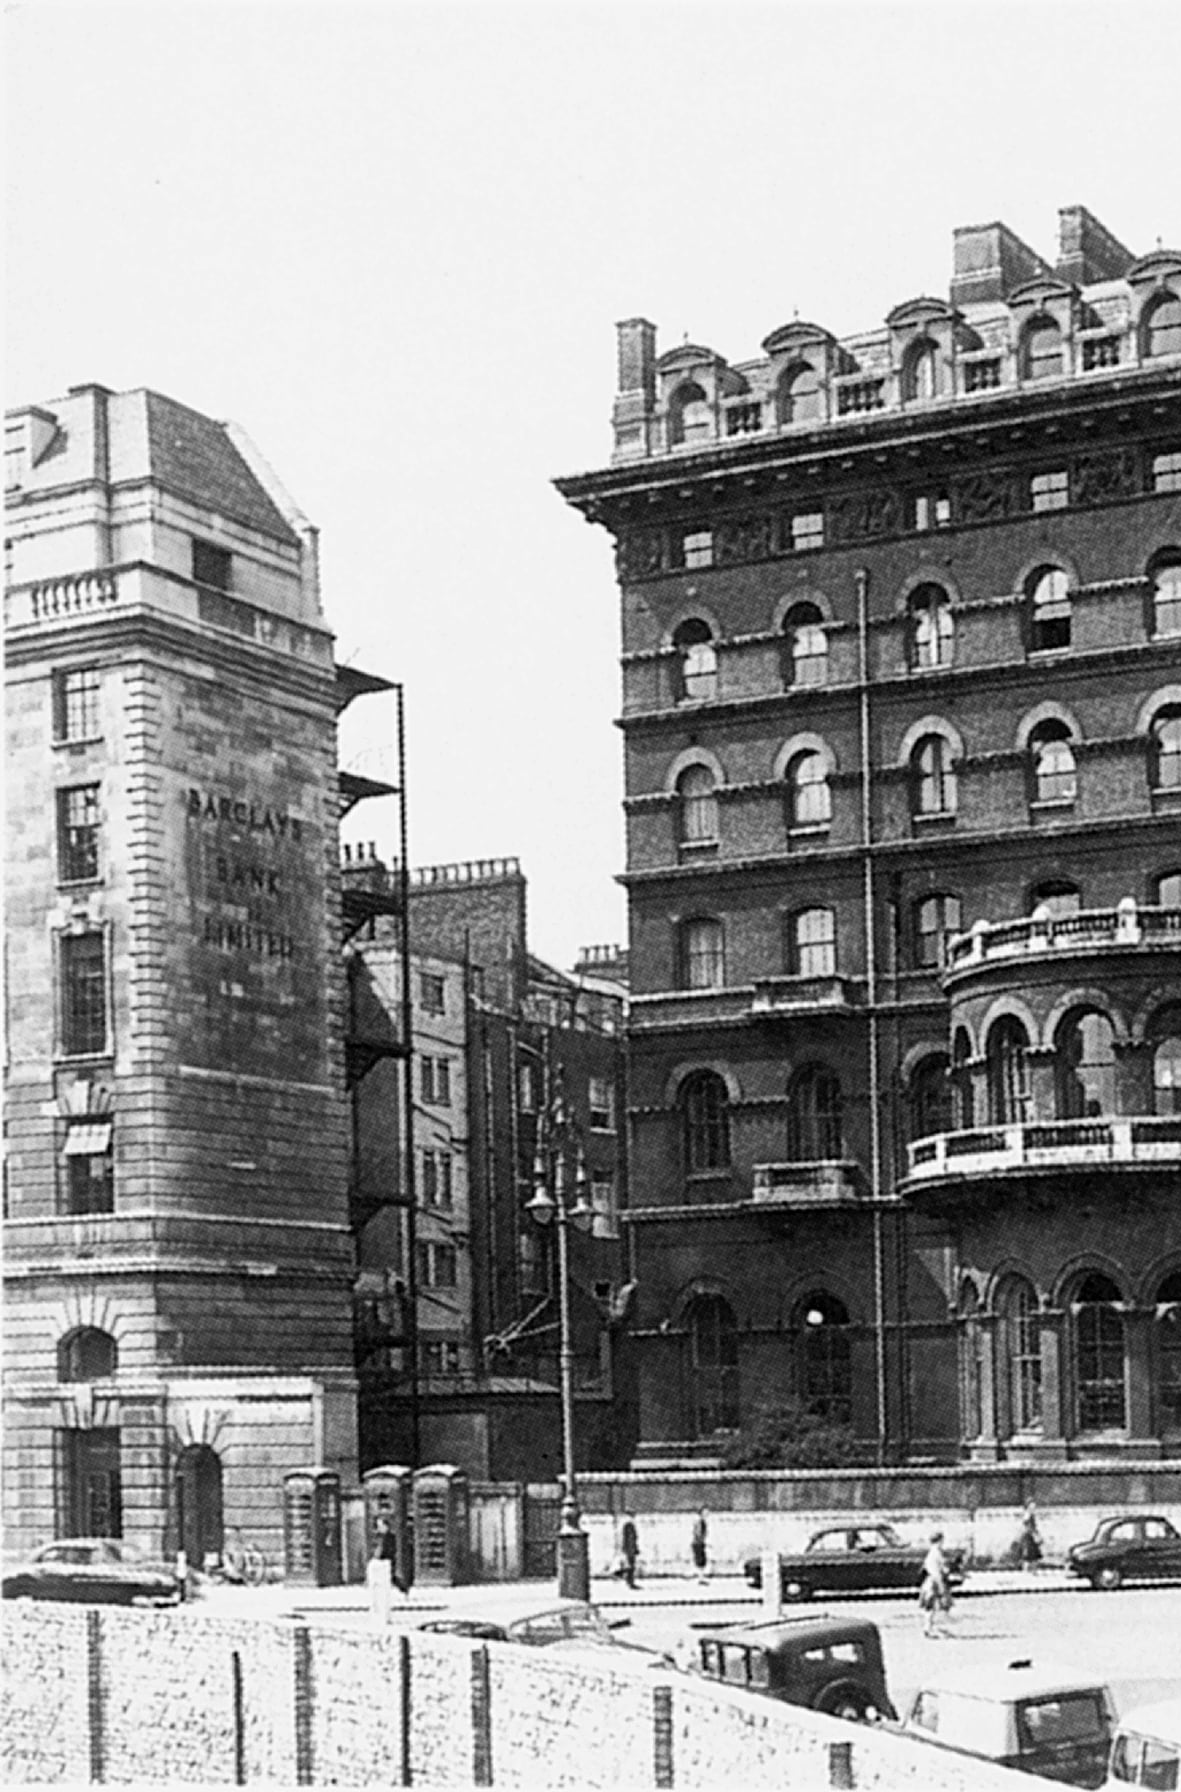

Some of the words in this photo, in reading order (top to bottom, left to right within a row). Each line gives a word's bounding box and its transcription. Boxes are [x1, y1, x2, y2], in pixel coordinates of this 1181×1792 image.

[188, 788, 302, 842] BARCLAYS
[217, 857, 280, 895] BANK
[203, 917, 294, 958] LIMITED
